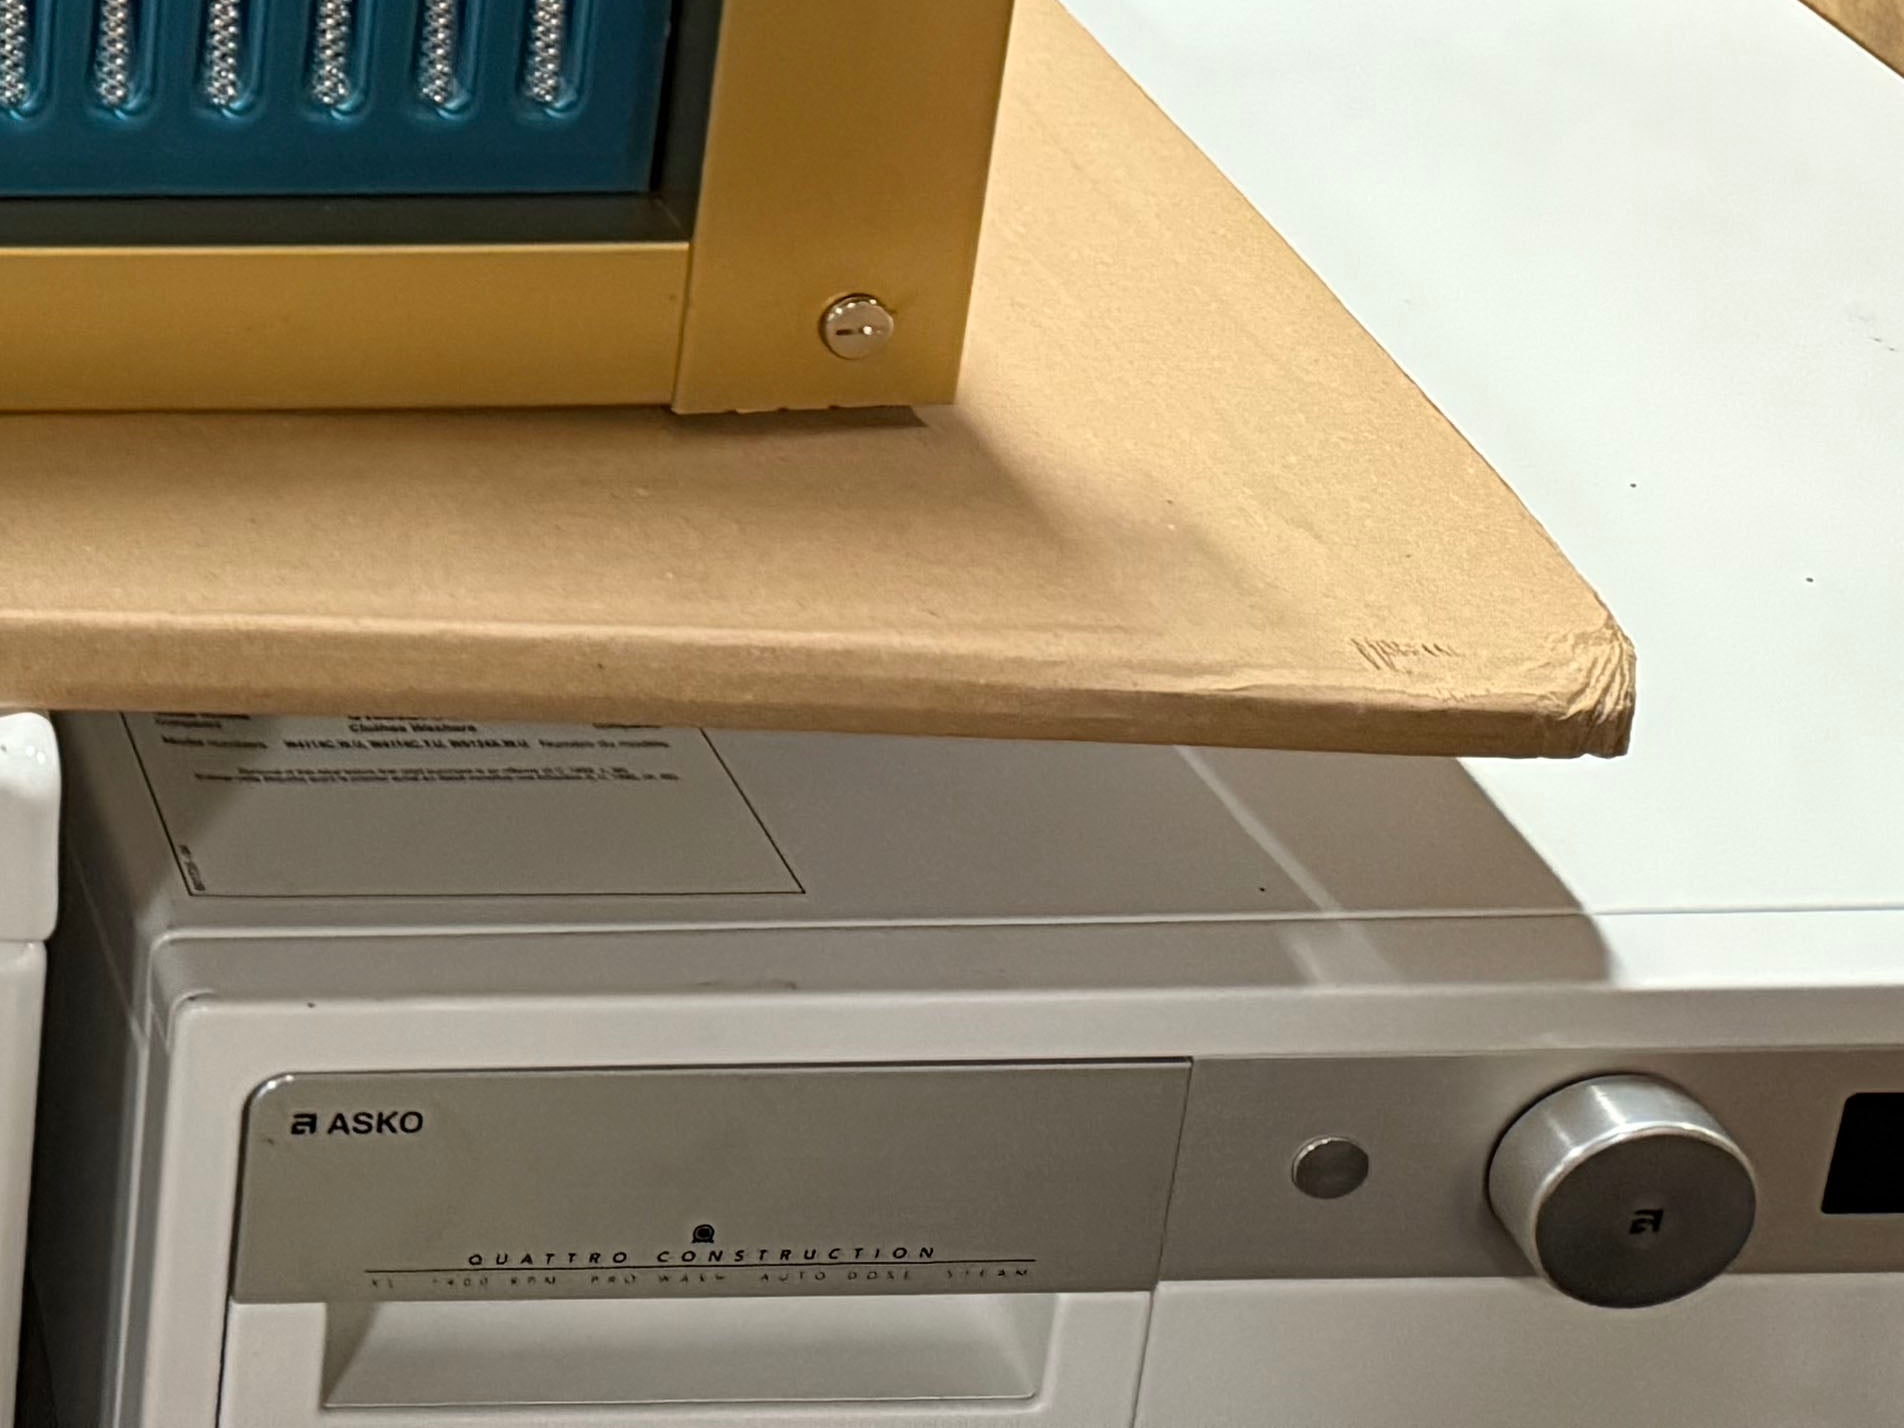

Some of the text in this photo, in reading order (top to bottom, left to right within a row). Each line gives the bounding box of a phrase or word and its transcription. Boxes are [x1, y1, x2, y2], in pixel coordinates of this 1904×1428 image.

[327, 1111, 424, 1135] ASKO
[468, 1247, 934, 1266] QUATTRO CONSTRUCTION
